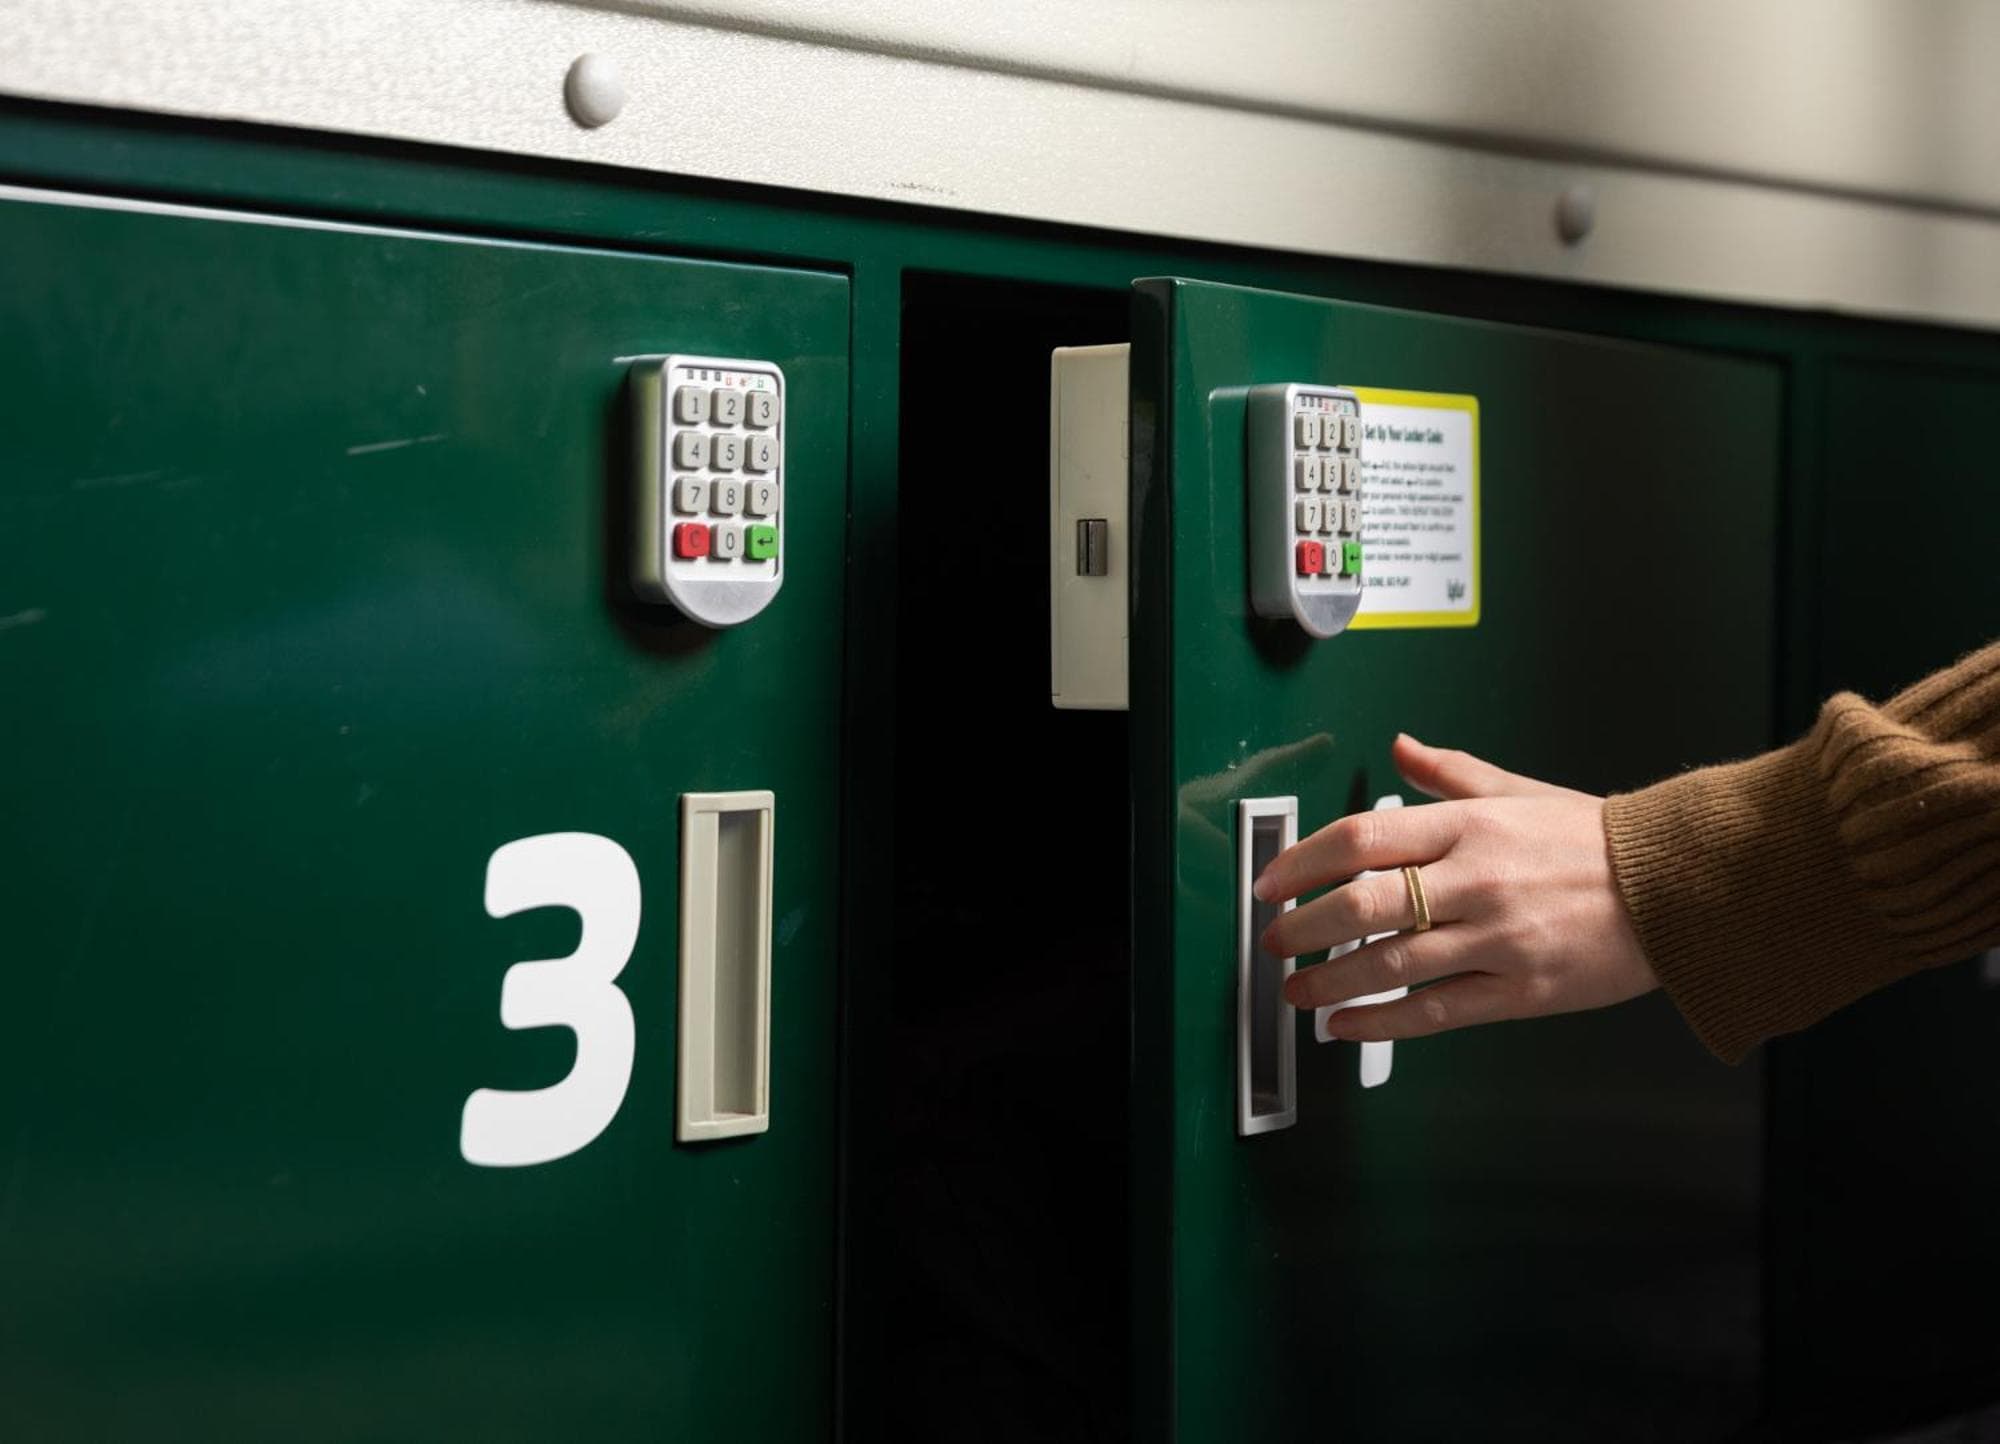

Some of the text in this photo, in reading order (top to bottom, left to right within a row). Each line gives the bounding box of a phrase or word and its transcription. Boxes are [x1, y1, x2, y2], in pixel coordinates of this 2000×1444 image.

[726, 398, 736, 416] 2
[760, 400, 770, 418] 3
[690, 441, 769, 463] 4 5 6
[690, 486, 769, 507] 7 8 9
[726, 532, 735, 551] 0
[460, 831, 642, 1167] 3
